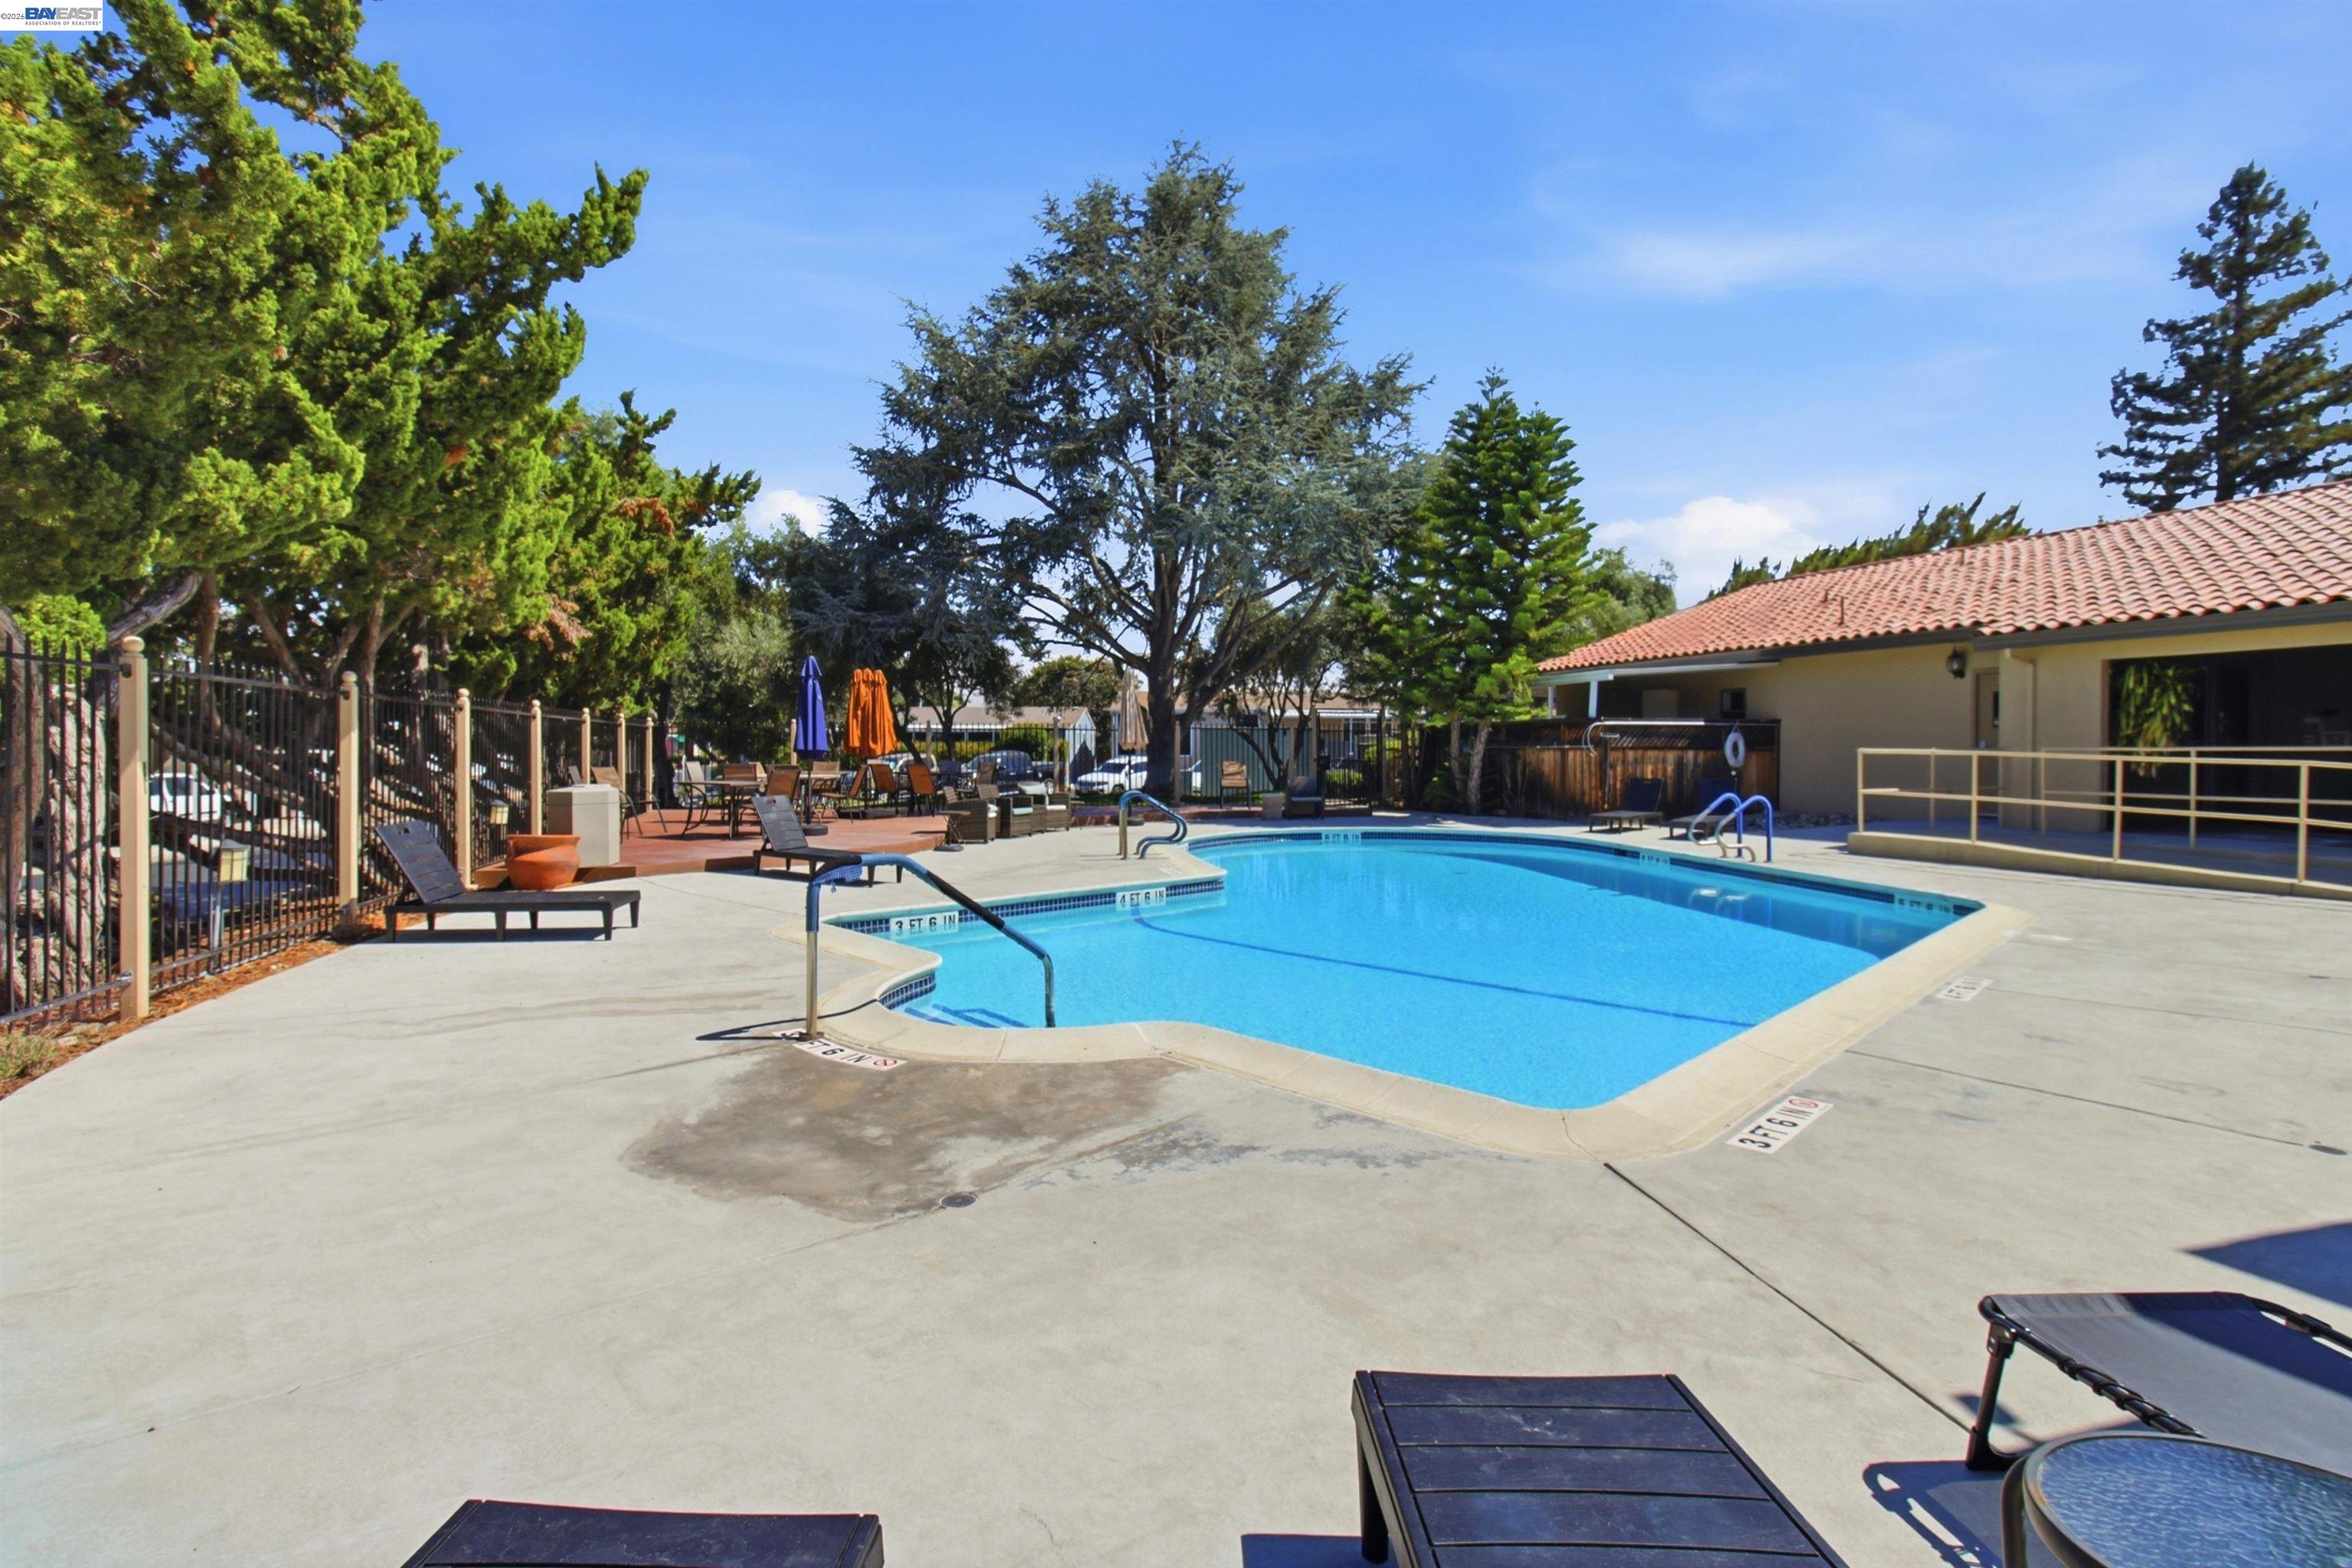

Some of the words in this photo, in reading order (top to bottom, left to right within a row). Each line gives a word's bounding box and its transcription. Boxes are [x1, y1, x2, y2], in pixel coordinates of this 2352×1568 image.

[1129, 892, 1140, 903] FT
[1155, 890, 1164, 900] IN
[909, 918, 923, 929] FT
[943, 914, 956, 926] IN
[822, 1047, 844, 1056] 6
[840, 1053, 872, 1063] IN
[1775, 1106, 1814, 1120] IN
[1766, 1117, 1798, 1128] 6
[1749, 1125, 1788, 1141] FT
[1738, 1138, 1772, 1148] 3
